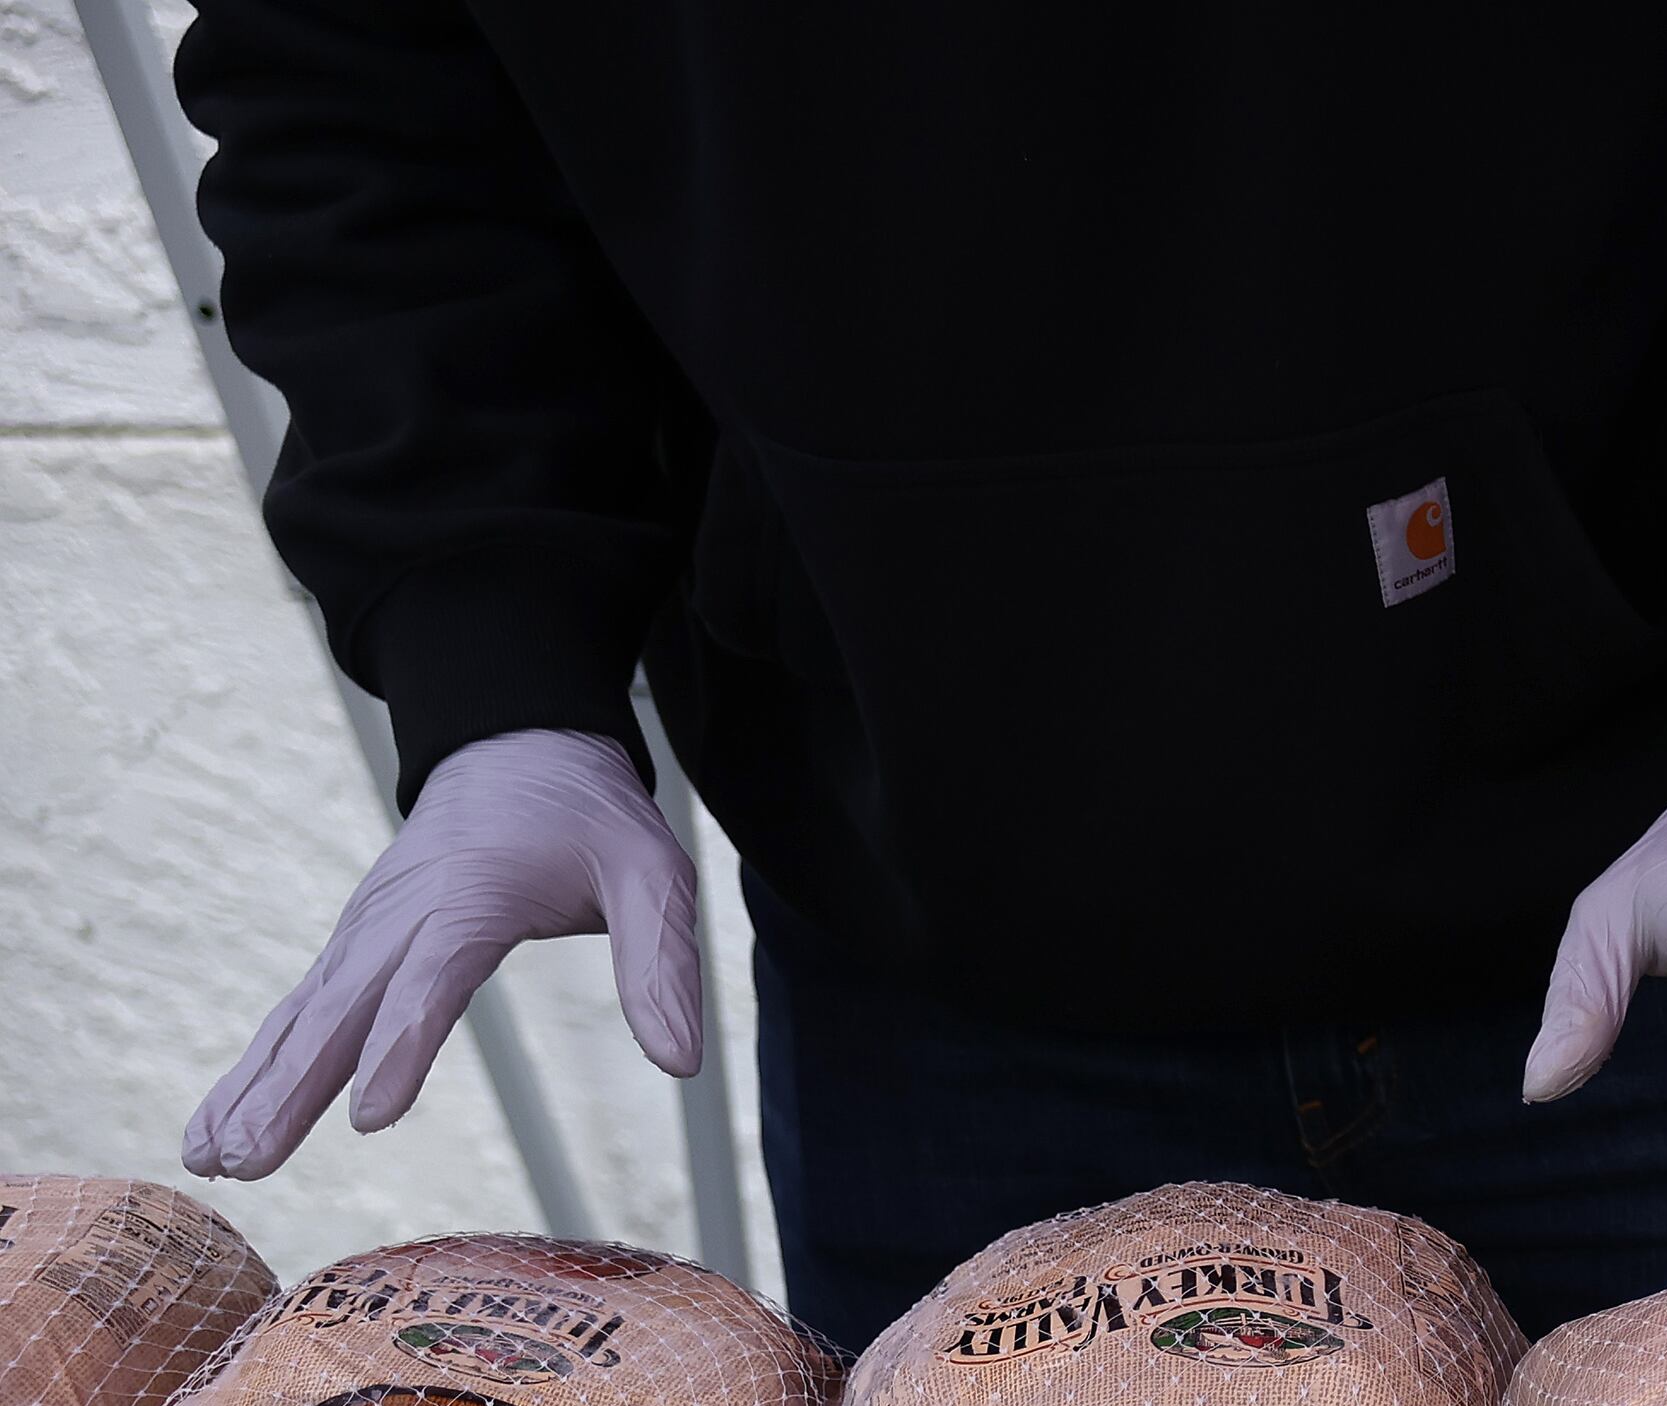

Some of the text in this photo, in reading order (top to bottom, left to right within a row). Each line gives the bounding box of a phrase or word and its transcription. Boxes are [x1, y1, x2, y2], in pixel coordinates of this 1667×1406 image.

[1394, 557, 1448, 590] carhartt
[1140, 1244, 1304, 1268] GROWER-OWNED
[395, 1291, 626, 1369] TURKEY
[944, 1265, 1374, 1356] TURKEY VALLEY
